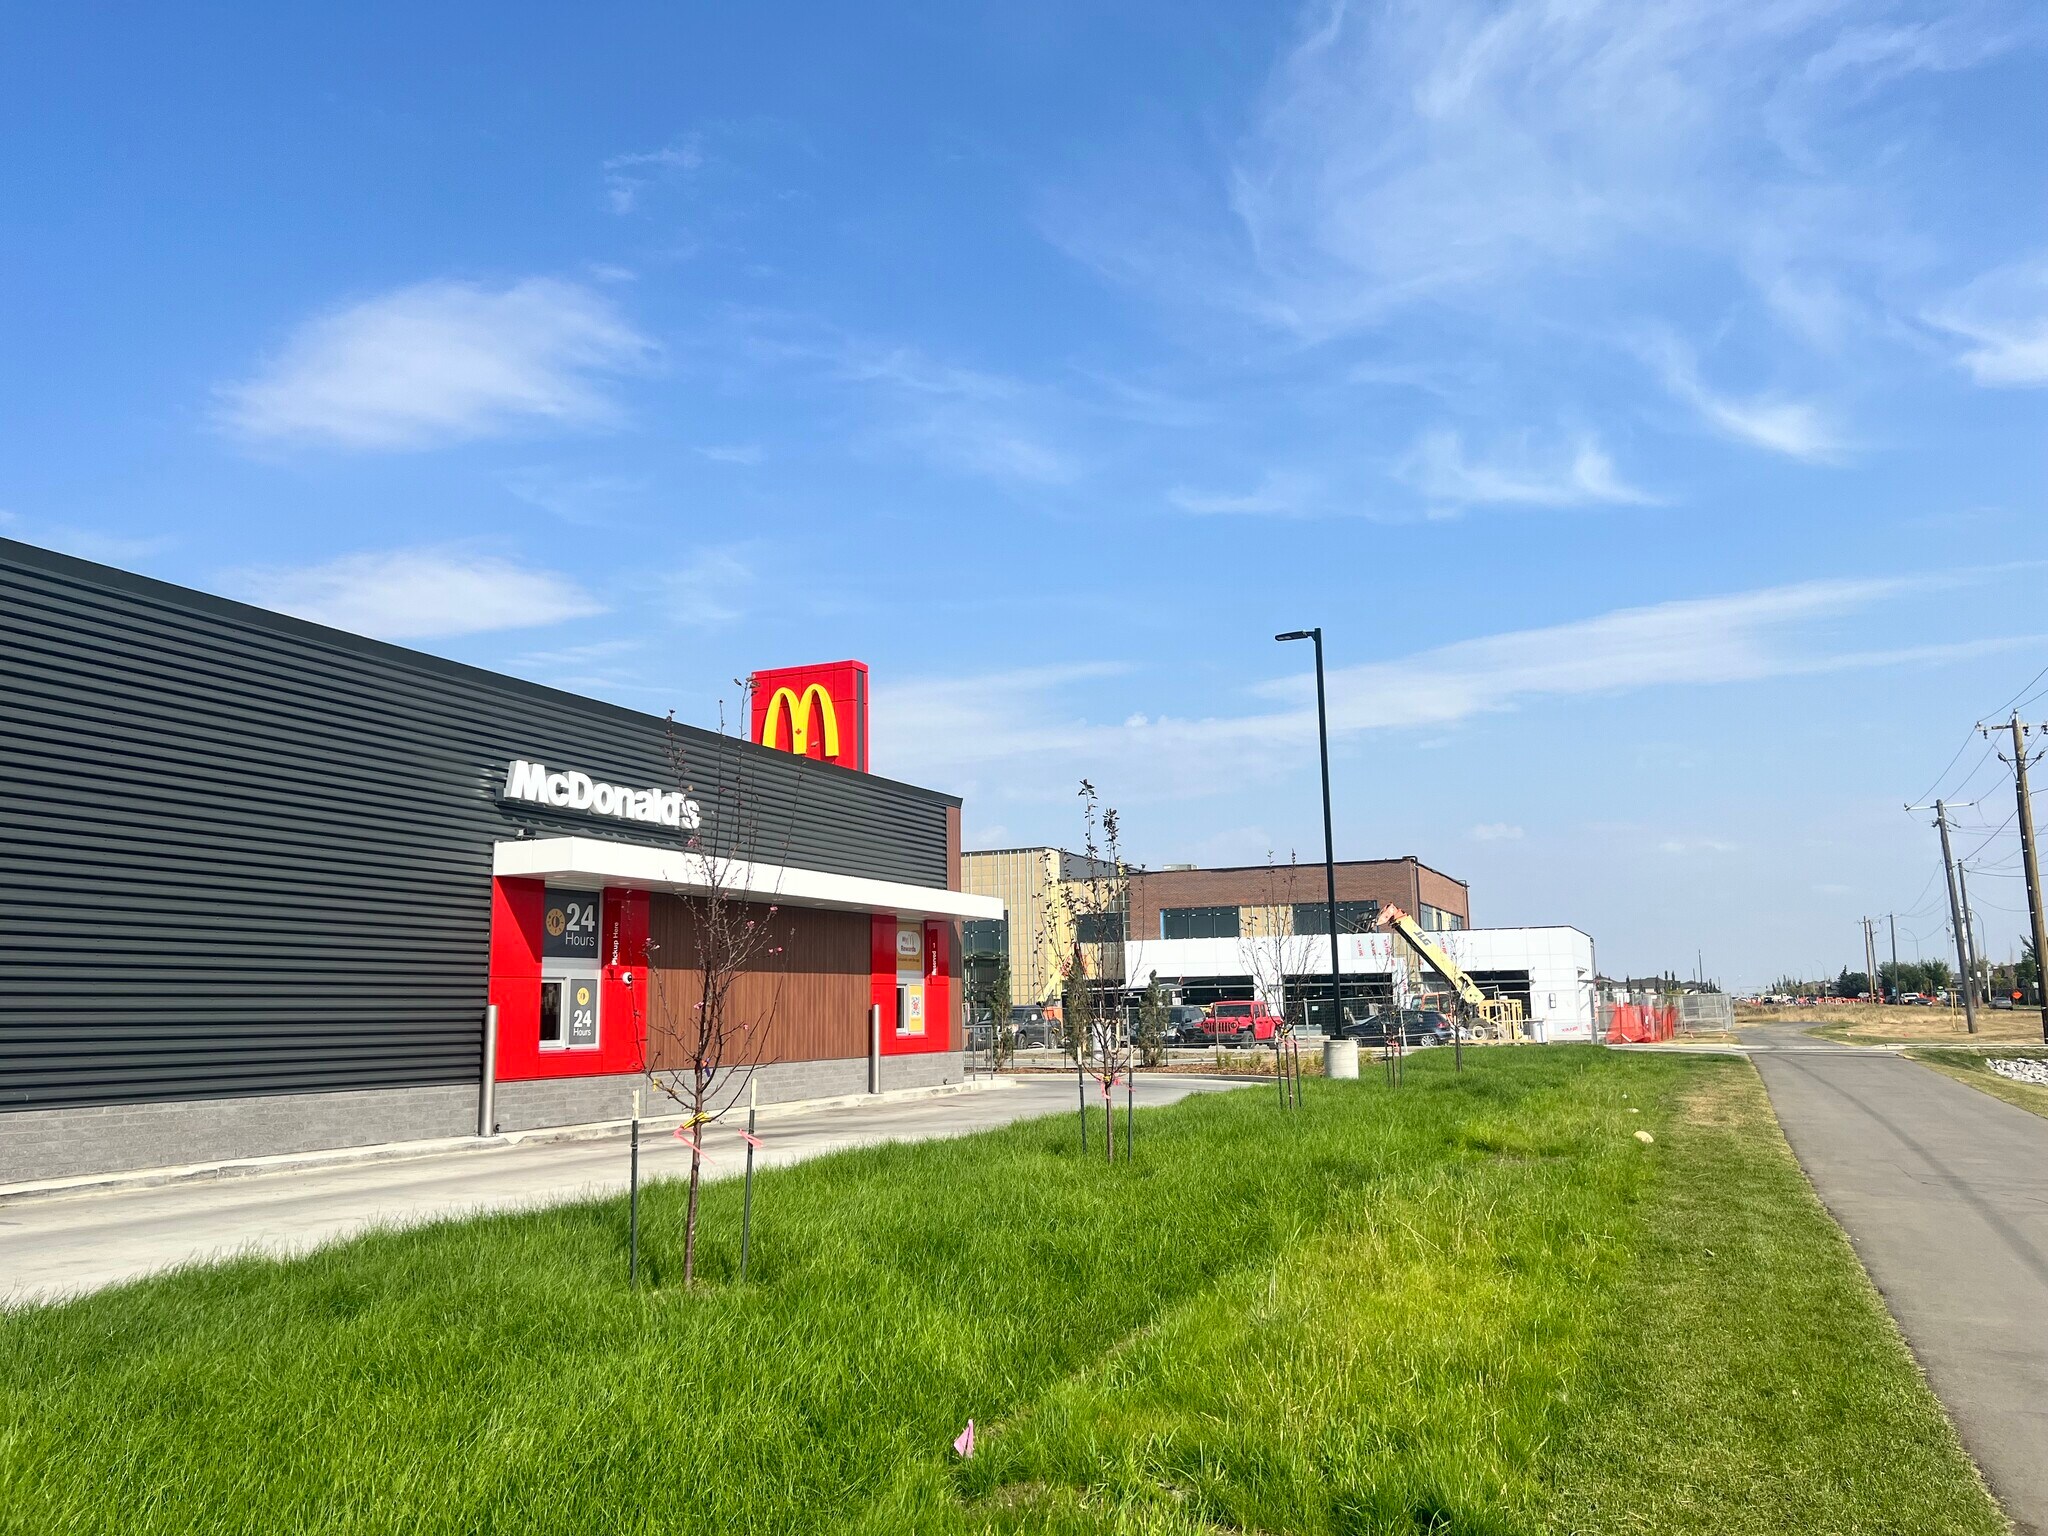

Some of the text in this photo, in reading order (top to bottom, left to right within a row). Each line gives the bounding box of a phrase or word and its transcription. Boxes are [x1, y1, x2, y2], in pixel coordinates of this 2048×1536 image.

[504, 759, 701, 830] McDonald's
[566, 902, 596, 932] 24
[565, 931, 595, 947] Hours
[1413, 930, 1432, 947] JLG
[611, 939, 619, 966] Pickup
[573, 1009, 593, 1028] 24
[573, 1027, 592, 1037] Hours
